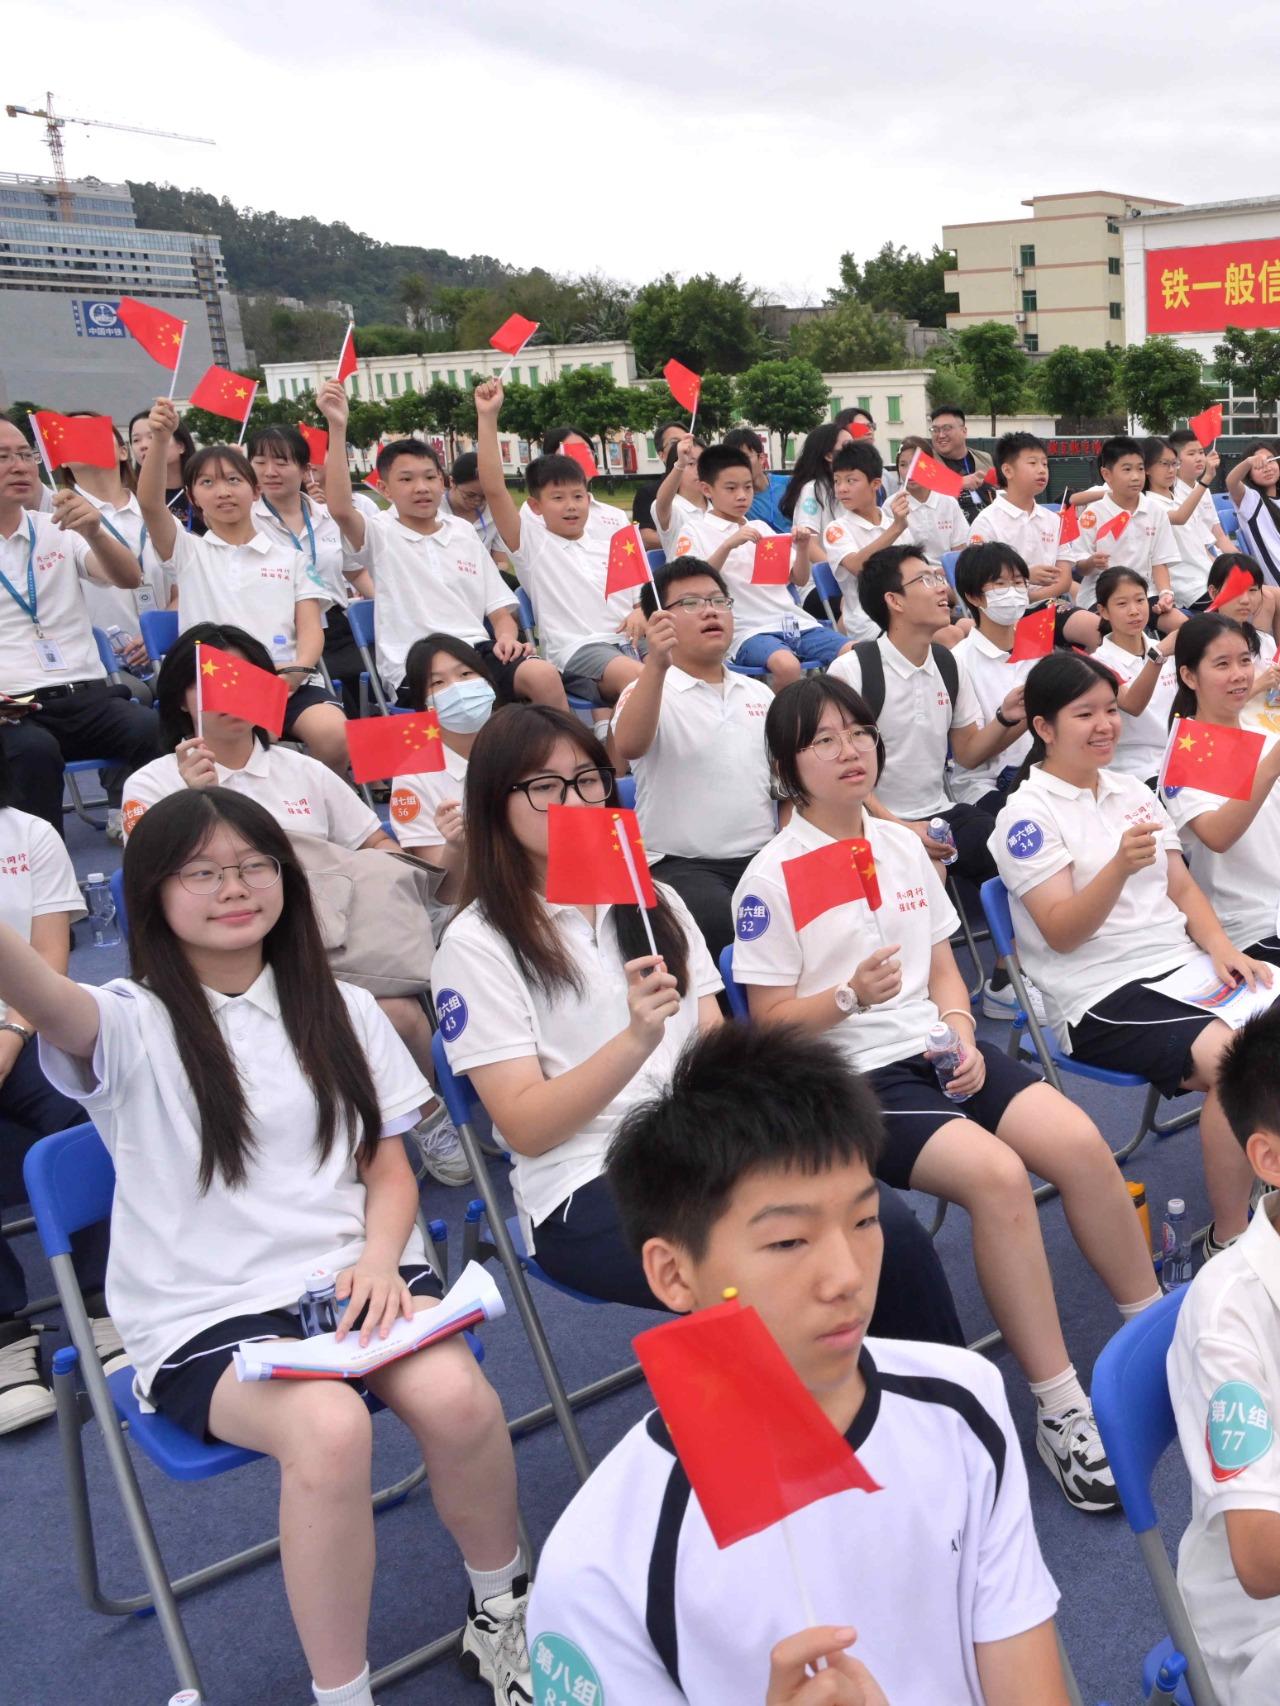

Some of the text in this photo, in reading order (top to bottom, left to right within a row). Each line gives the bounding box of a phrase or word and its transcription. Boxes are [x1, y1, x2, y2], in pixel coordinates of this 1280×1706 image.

[88, 327, 123, 338] 中国中铁
[398, 808, 409, 817] 56
[1007, 822, 1037, 847] 第六组
[1020, 840, 1033, 852] 34
[741, 920, 754, 932] 52
[445, 1017, 457, 1032] 43
[1210, 1400, 1268, 1431] 第八组
[1220, 1430, 1246, 1452] 77
[535, 1641, 598, 1706] 第八组
[544, 1687, 567, 1706] 8
